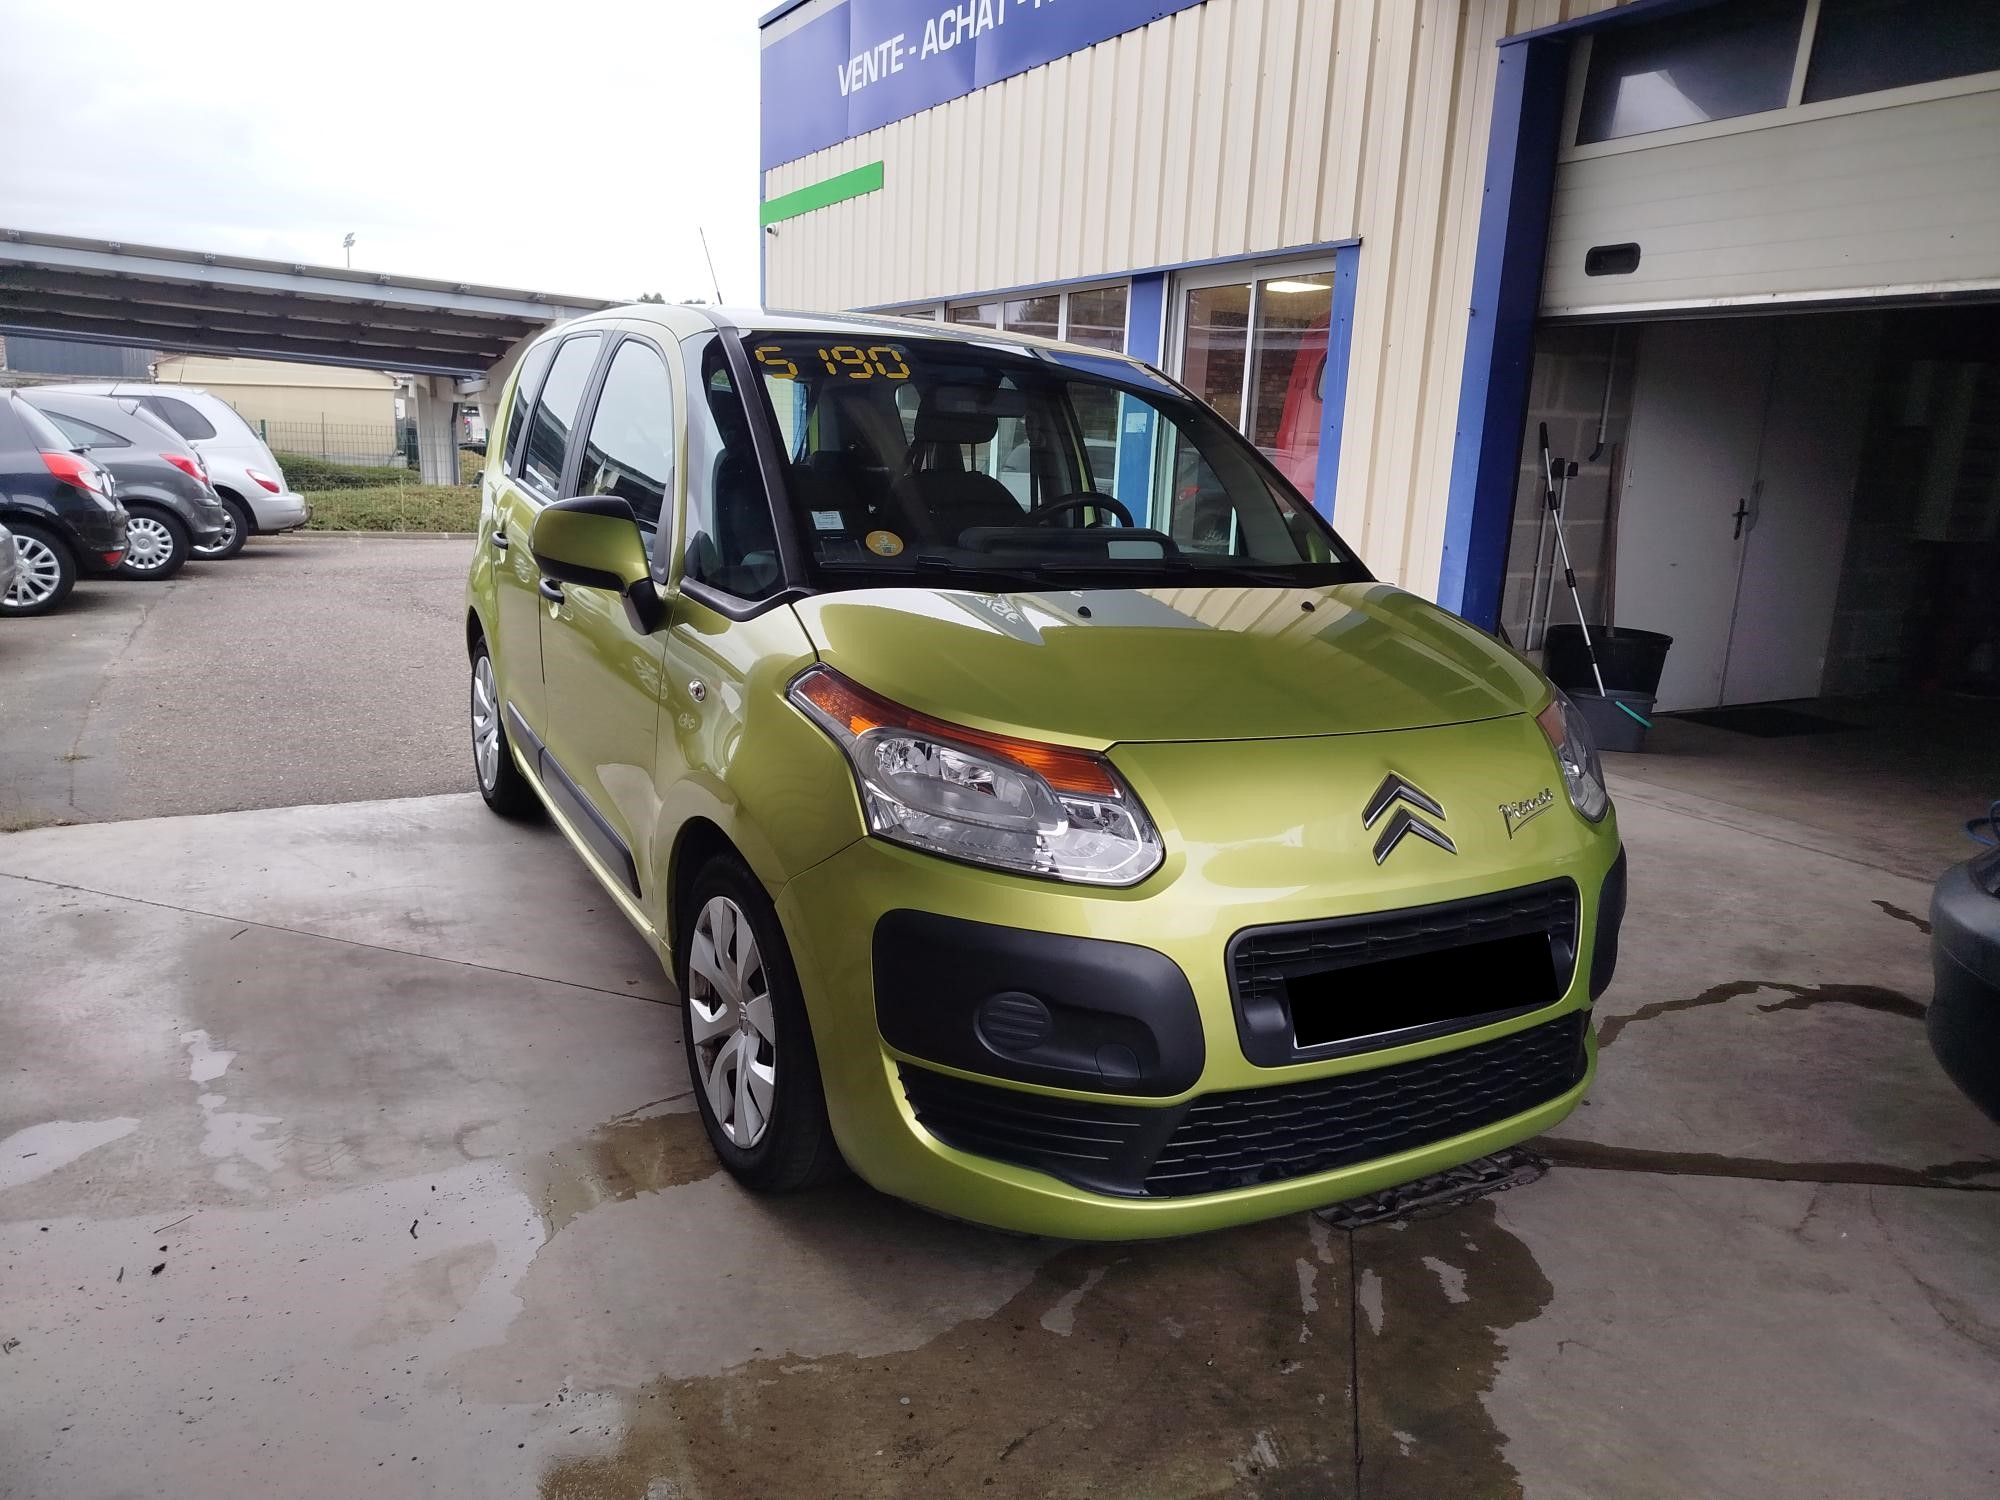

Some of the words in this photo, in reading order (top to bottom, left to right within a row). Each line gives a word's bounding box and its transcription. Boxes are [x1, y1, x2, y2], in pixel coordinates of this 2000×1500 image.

[838, 33, 905, 97] VENTE
[755, 346, 798, 379] 5
[819, 346, 911, 379] 190
